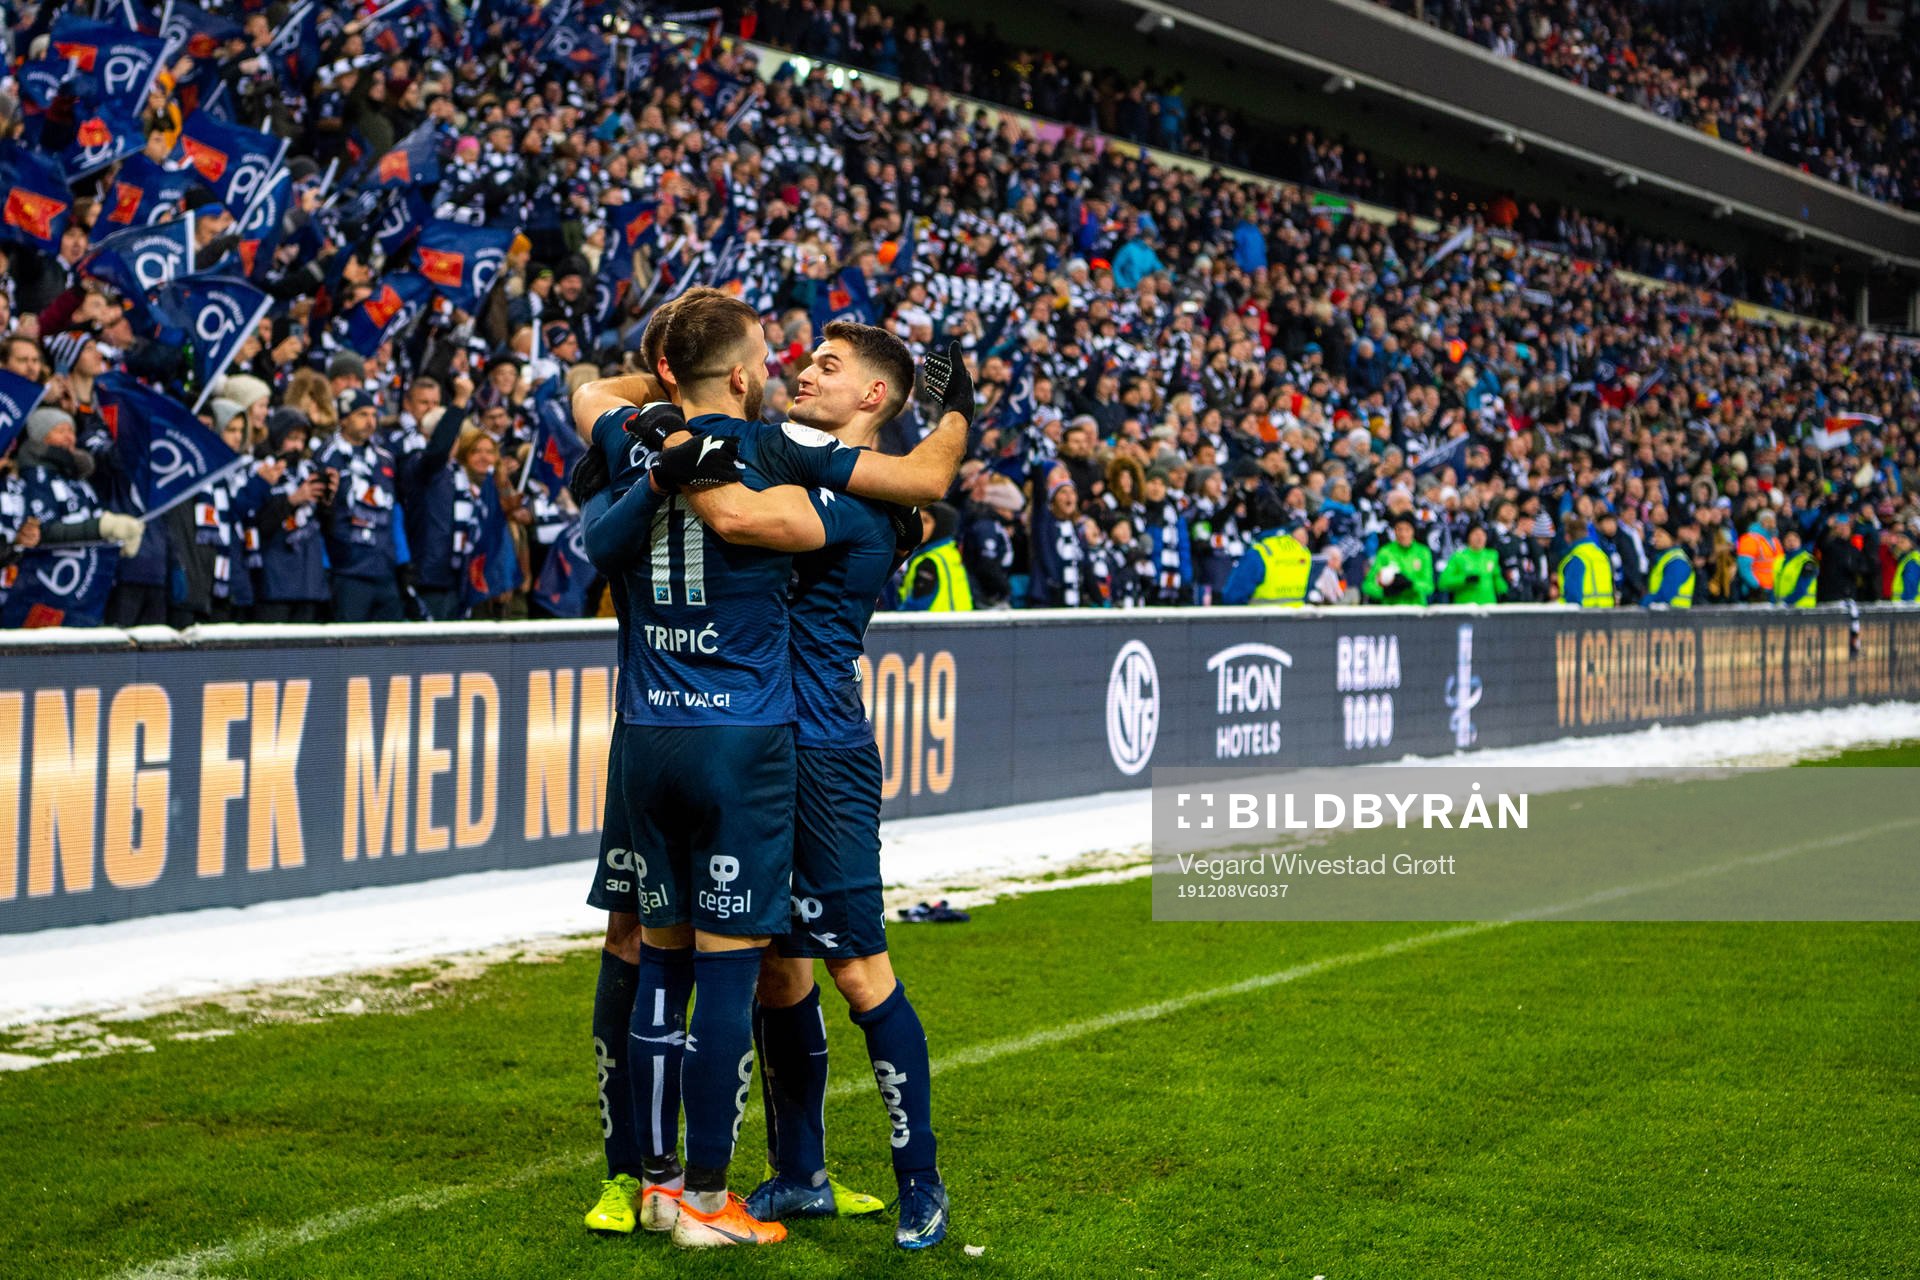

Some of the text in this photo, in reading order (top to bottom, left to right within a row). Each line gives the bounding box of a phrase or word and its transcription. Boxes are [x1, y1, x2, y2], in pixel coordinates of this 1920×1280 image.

[650, 494, 706, 605] 11
[645, 623, 719, 655] TRIPIĆ
[1336, 634, 1401, 692] REMA
[648, 689, 730, 708] MITT VALG!
[1207, 642, 1292, 714] THON
[1216, 720, 1281, 758] HOTELS
[1343, 694, 1395, 750] 1000
[197, 679, 311, 878] FK
[343, 672, 500, 862] MED
[699, 889, 751, 919] cegal
[873, 1059, 910, 1149] coop
